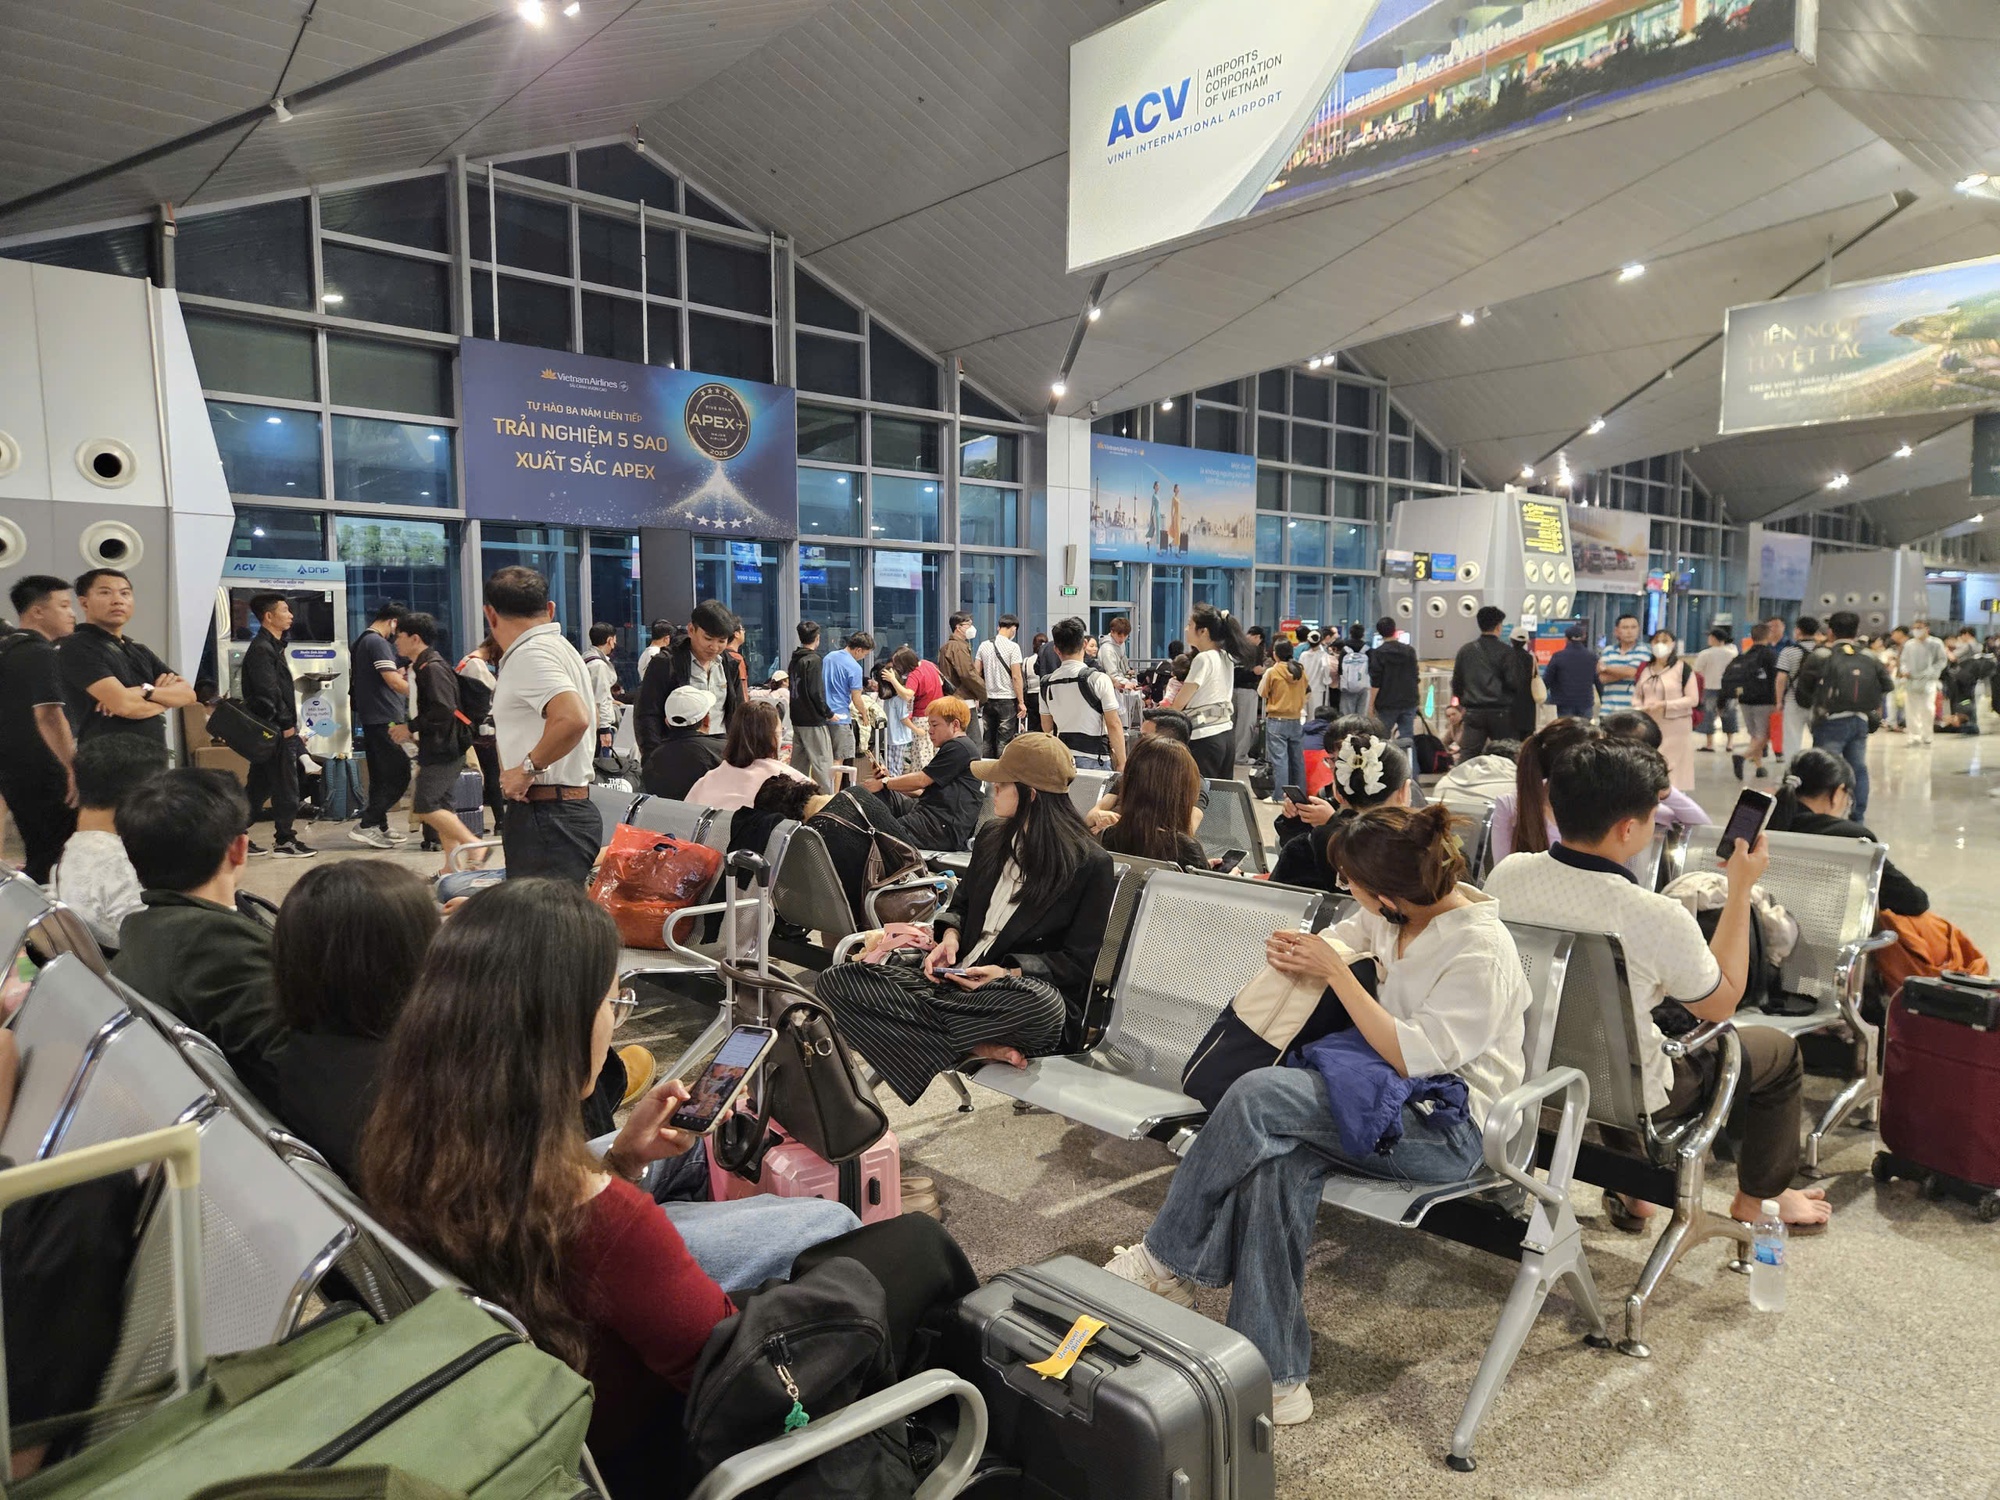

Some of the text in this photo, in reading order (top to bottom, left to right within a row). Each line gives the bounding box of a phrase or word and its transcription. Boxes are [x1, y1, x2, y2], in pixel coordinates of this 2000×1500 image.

[1205, 49, 1259, 80] AIRPORTS
[1205, 54, 1282, 93] CORPORATION
[1205, 74, 1269, 107] OF VIETNAM
[1107, 77, 1191, 147] ACV
[1107, 91, 1282, 165] VINH INTERNATIONAL AIRPORT
[557, 372, 618, 389] VietnamAirlines
[527, 401, 643, 423] TỰ HÀO BA NĂM LIÊN TIẾP
[689, 413, 736, 431] APEX
[493, 414, 668, 452] TRẢI NGHIỆM 5 SAO
[516, 450, 656, 481] XUẤT SẮC APEX
[233, 563, 256, 571] ACV
[1415, 561, 1426, 579] 3
[1057, 1330, 1080, 1360] Vietravel
[1070, 1329, 1090, 1354] Airlines
